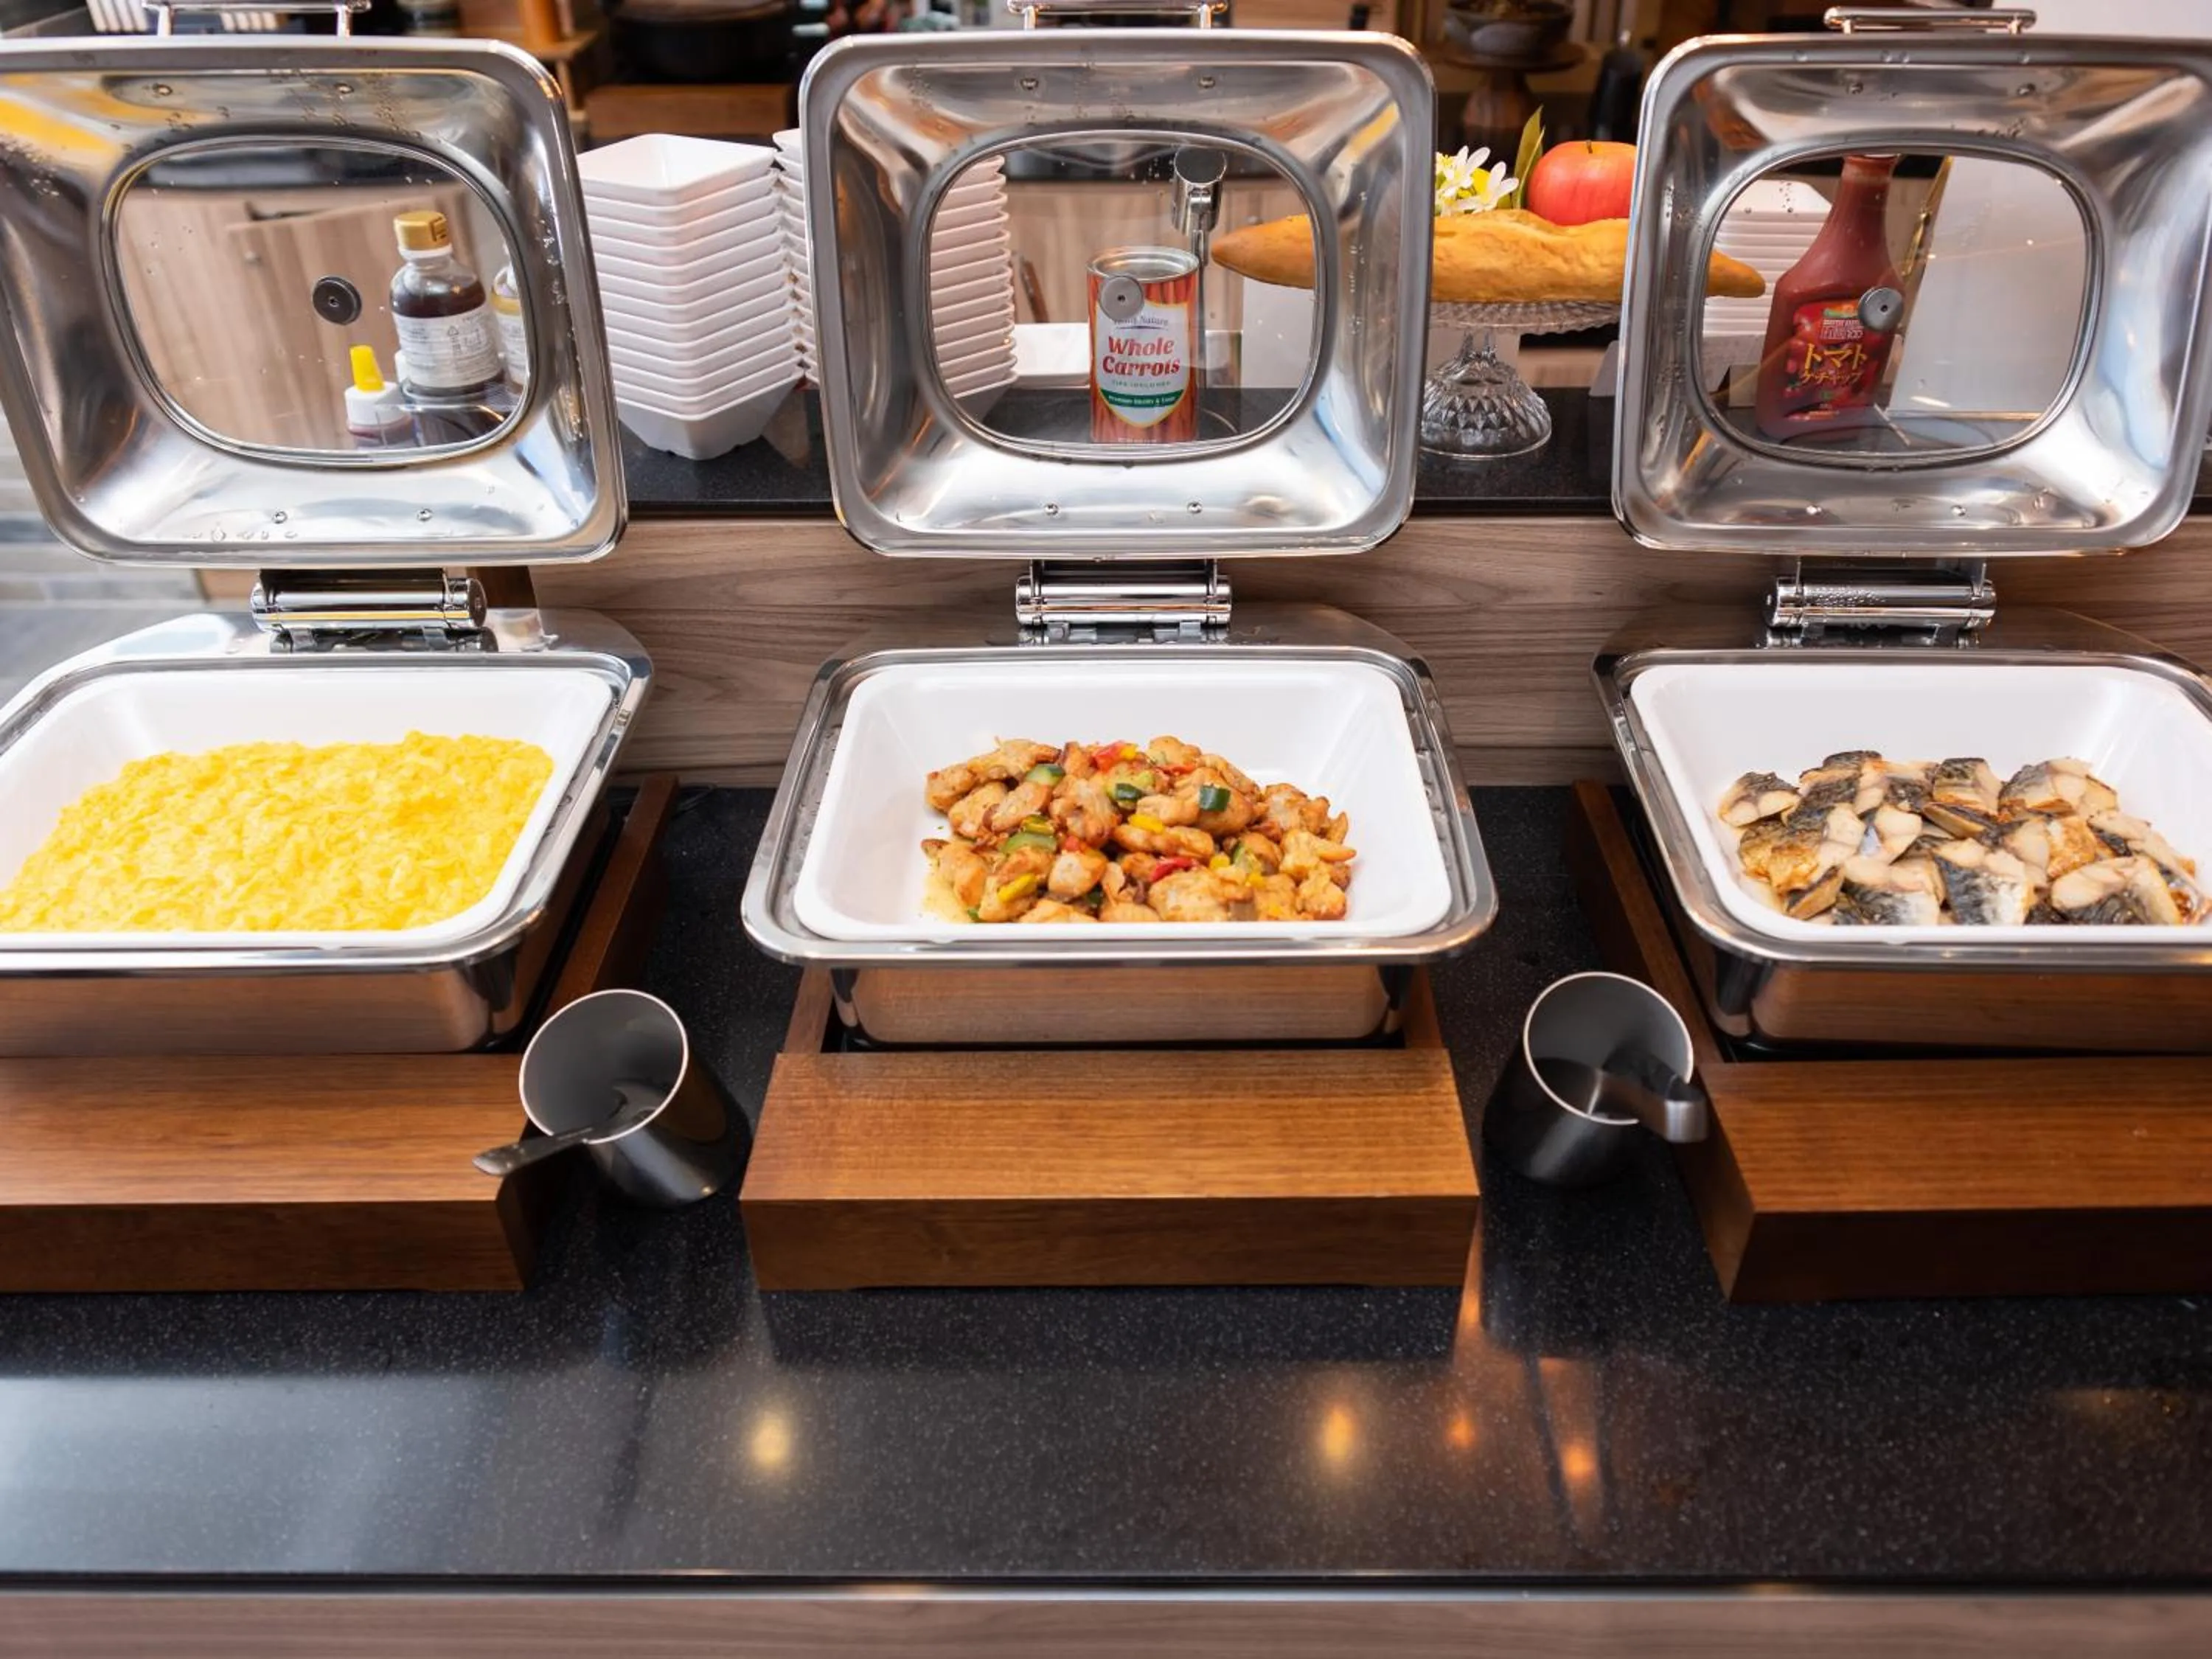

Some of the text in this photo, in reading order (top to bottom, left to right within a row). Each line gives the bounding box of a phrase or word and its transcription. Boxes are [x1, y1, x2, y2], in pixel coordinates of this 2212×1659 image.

[1108, 335, 1175, 357] Whole
[1804, 343, 1868, 372] トマト
